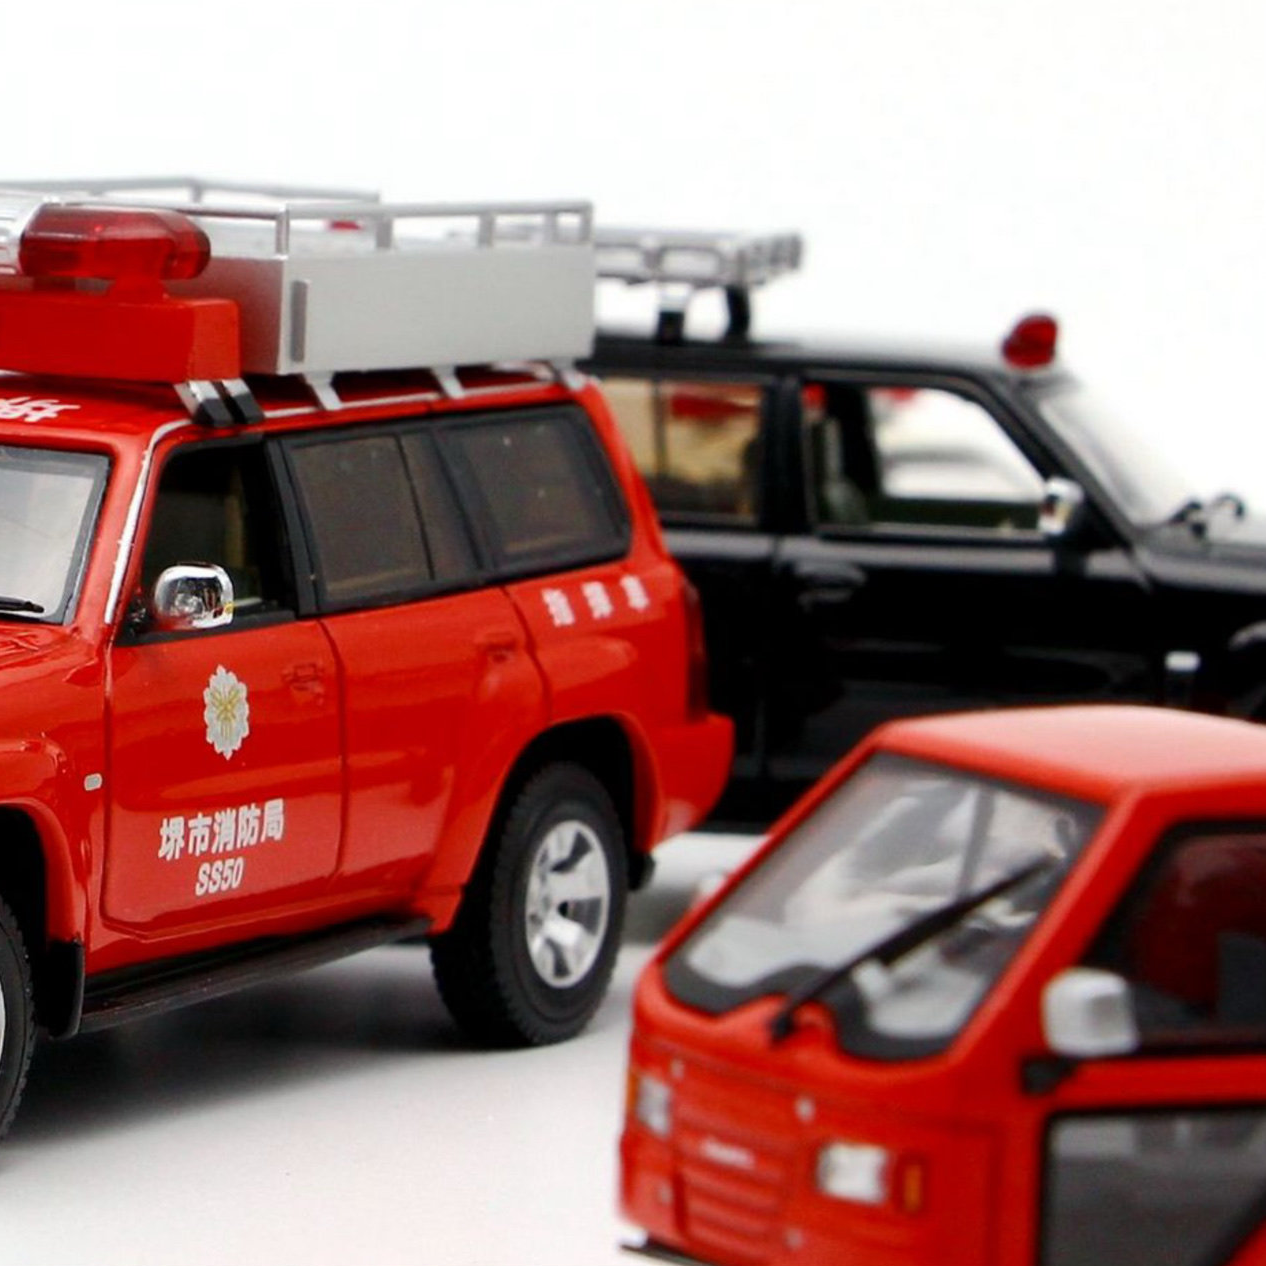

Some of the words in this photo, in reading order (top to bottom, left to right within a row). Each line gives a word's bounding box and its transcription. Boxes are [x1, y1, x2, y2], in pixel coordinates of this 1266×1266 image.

[157, 798, 284, 861] 堺市消防局
[195, 857, 244, 896] SS50
